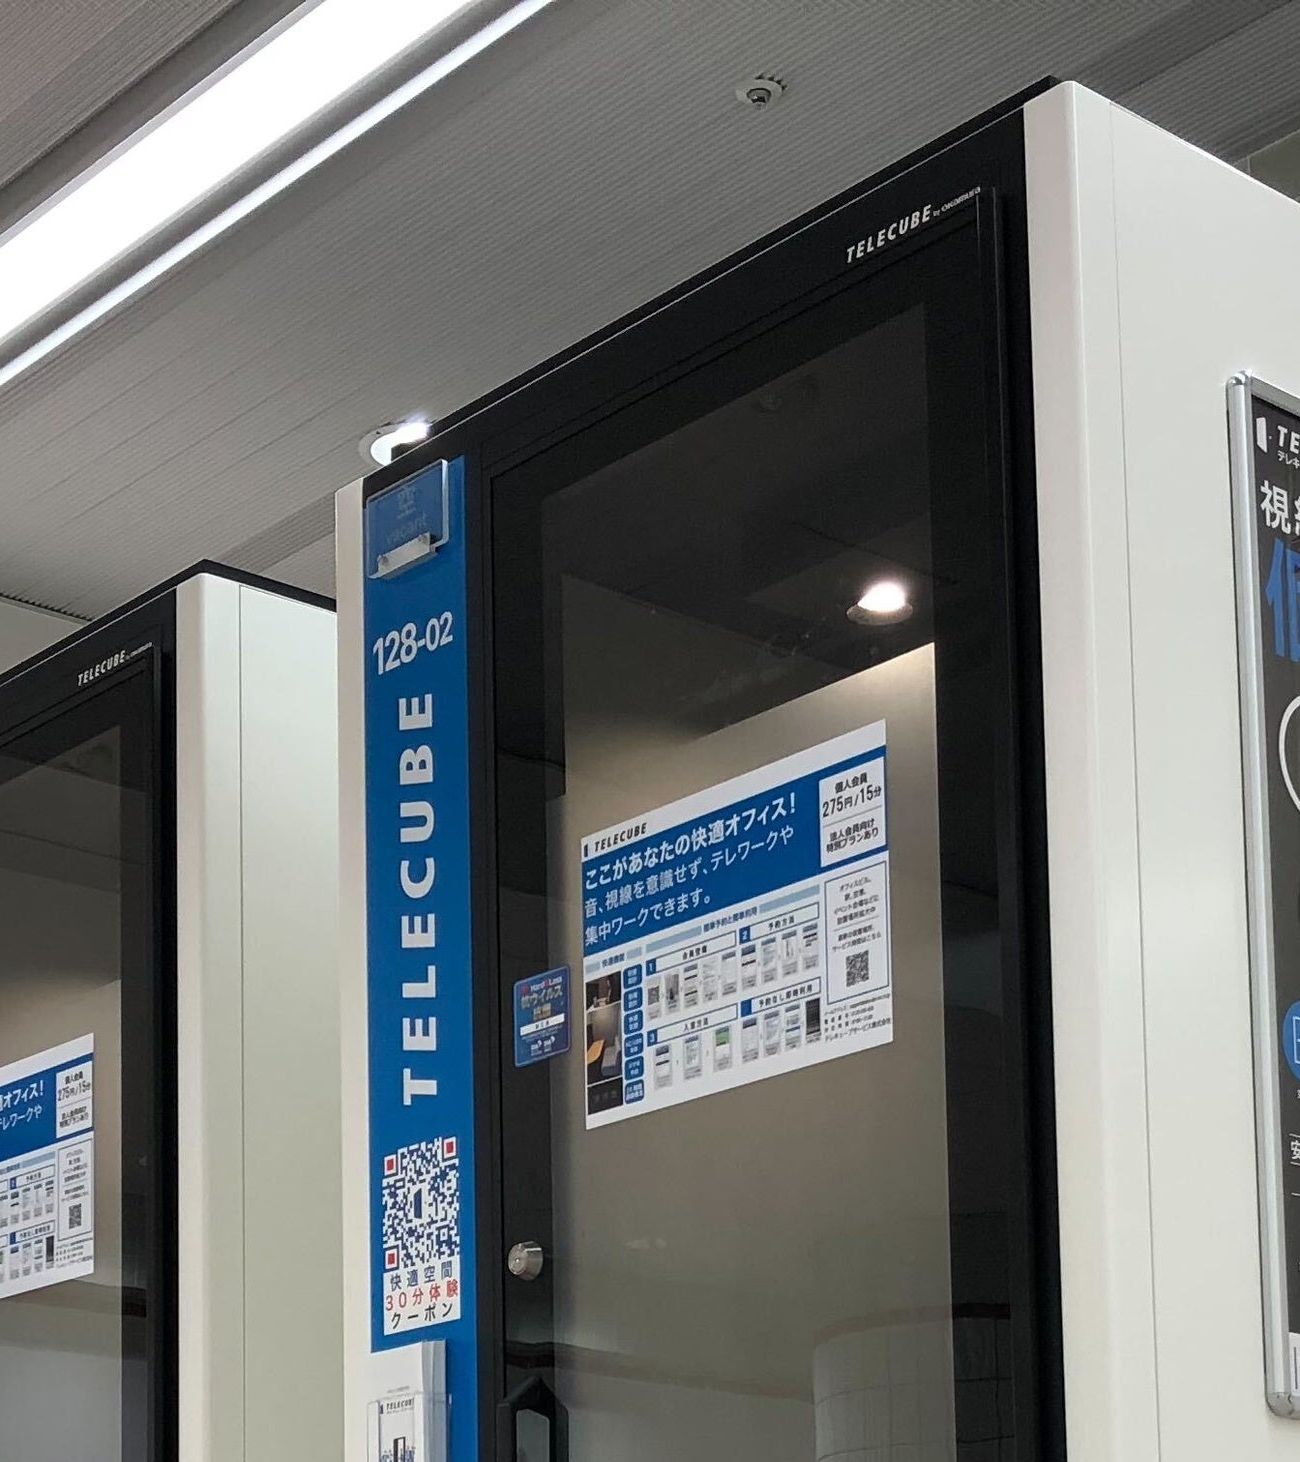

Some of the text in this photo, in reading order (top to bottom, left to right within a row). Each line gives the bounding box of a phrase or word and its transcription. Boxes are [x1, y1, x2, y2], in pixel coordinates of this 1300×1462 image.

[846, 204, 932, 264] TELECUBE
[372, 610, 454, 676] 128-02
[77, 649, 126, 687] TELECUBE
[834, 772, 868, 794] 個人会員
[584, 792, 796, 890] ここがあなたの快適オフィス!
[594, 822, 648, 852] TELECUBE
[584, 825, 794, 918] 音、視線を意識せず、テレワークや
[398, 693, 438, 1106] TELECUBE
[584, 887, 711, 947] 集中ワークできます。
[385, 1279, 460, 1312] 30分体験
[390, 1260, 453, 1292] 快適空間
[391, 1302, 454, 1330] クーポン
